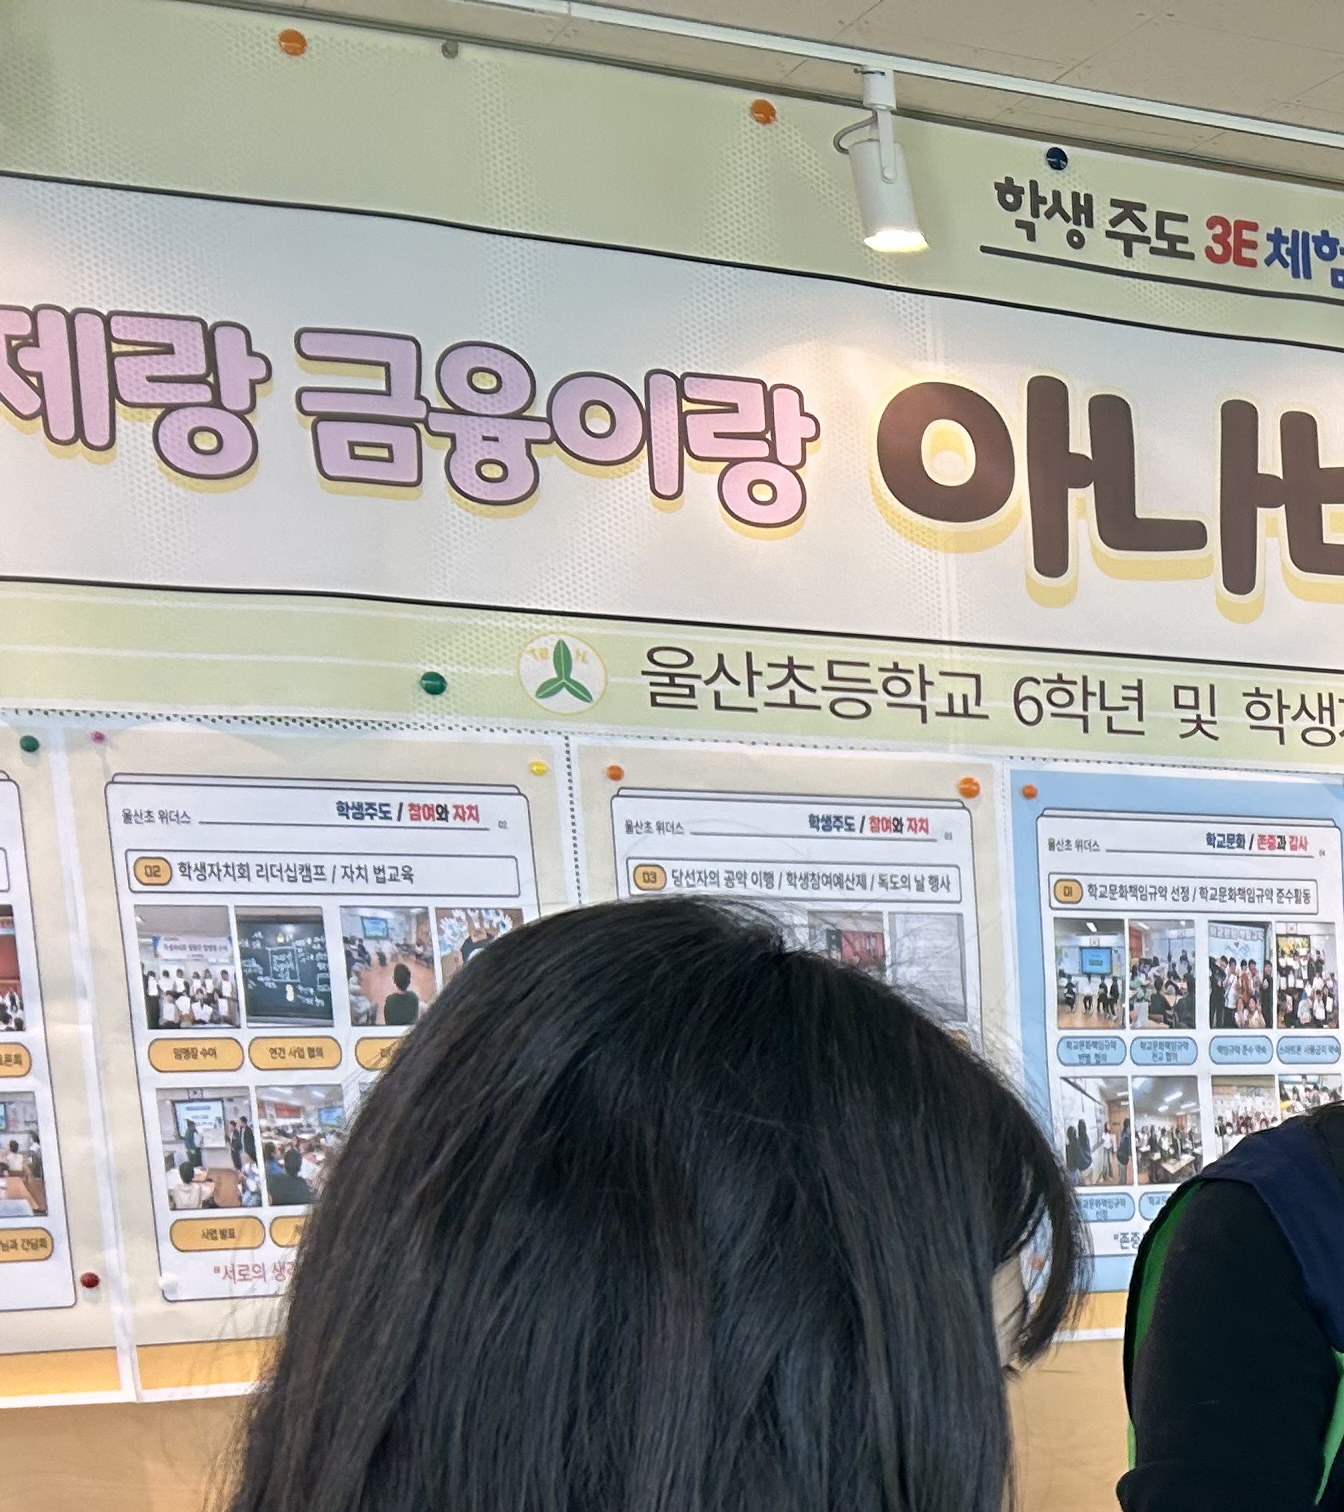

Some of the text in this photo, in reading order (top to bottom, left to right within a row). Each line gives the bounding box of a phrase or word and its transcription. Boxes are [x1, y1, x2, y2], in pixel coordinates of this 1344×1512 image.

[995, 176, 1095, 248] 학생
[1108, 198, 1195, 262] 주도
[1204, 214, 1259, 270] 3E
[294, 325, 822, 530] 금융이랑
[640, 645, 990, 723] 울산초등학교
[1012, 673, 1147, 739] 6학년
[1174, 686, 1220, 743] 및
[158, 809, 191, 826] 위더스
[336, 800, 392, 821] 학생주도
[408, 803, 449, 823] 참여와
[452, 804, 480, 824] 자치
[656, 821, 684, 835] 위더스
[808, 813, 856, 833] 학생주도
[869, 815, 904, 834] 참여와
[907, 817, 929, 835] 자치
[1206, 832, 1246, 850] 학교문화
[1257, 833, 1287, 851] 존중과
[1289, 835, 1309, 852] 감사
[144, 865, 162, 878] 02
[177, 861, 251, 882] 학생자치회
[255, 863, 327, 884] 리더십캠프
[341, 864, 369, 884] 자치
[372, 864, 414, 884] 법교육
[642, 872, 657, 884] 03
[671, 868, 720, 888] 당선자의
[723, 870, 748, 888] 공약
[751, 871, 775, 890] 이행
[786, 871, 867, 891] 학생참여예산제
[877, 873, 911, 892] 독도의
[914, 875, 926, 892] 날
[928, 875, 950, 893] 행사
[1087, 883, 1168, 901] 학교문화책임규약
[1171, 886, 1190, 902] 선정
[1199, 886, 1274, 904] 학교문화책임규약
[1276, 888, 1312, 905] 준수활동
